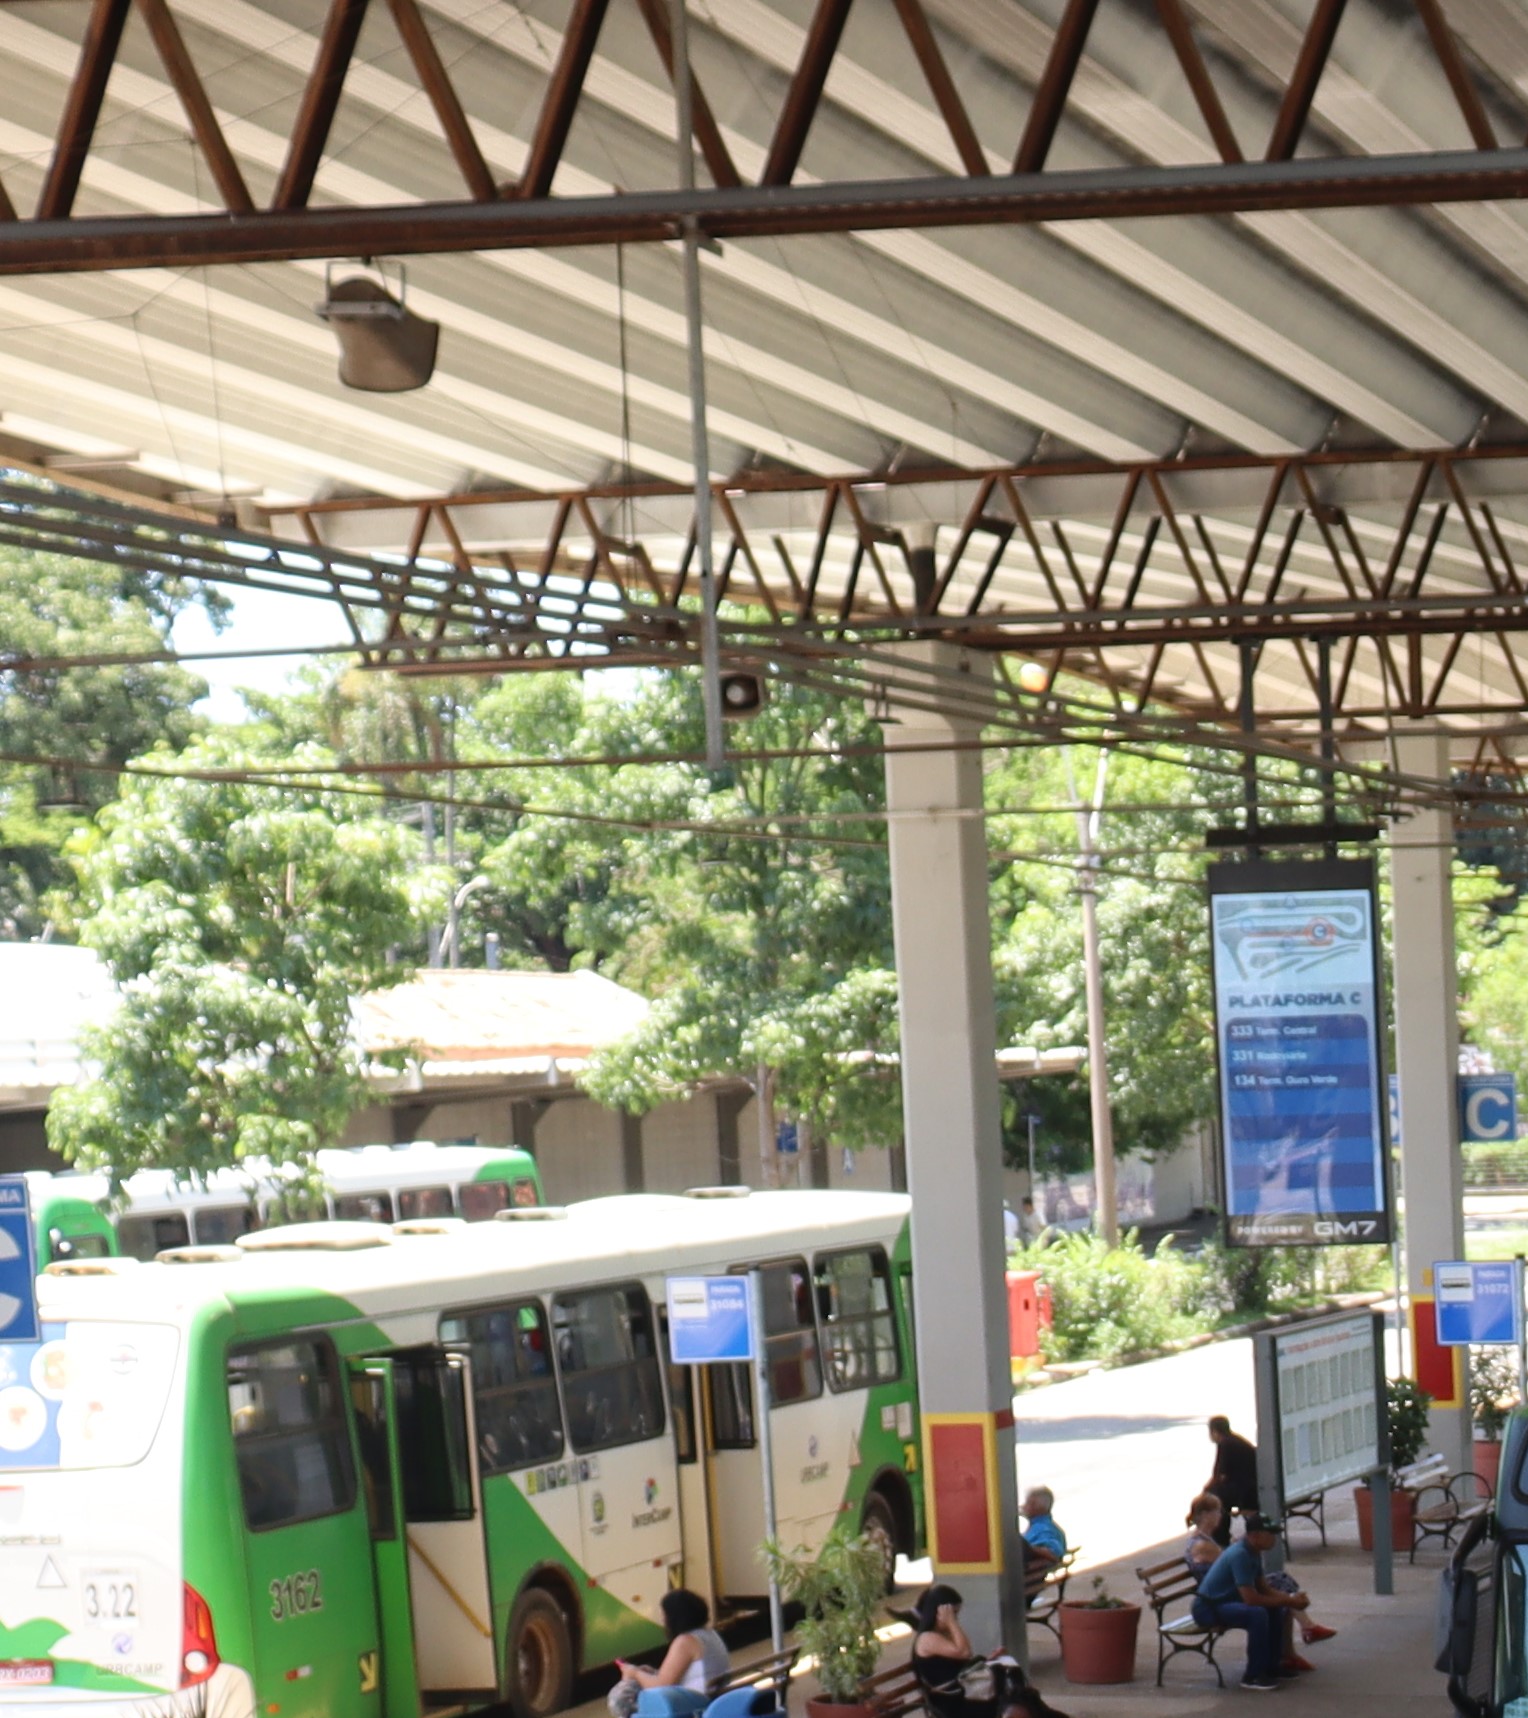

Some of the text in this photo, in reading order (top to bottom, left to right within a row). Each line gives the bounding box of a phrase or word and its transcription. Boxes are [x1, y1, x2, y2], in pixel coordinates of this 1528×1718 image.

[1229, 992, 1362, 1008] PLATAFORMA C
[1231, 1025, 1253, 1036] 333
[1283, 1026, 1317, 1034] Central
[1232, 1050, 1253, 1061] 331
[1235, 1074, 1255, 1086] 134
[1466, 1088, 1510, 1138] C
[1313, 1220, 1378, 1236] GM7
[85, 1582, 137, 1619] 3.22
[268, 1569, 323, 1622] 3162
